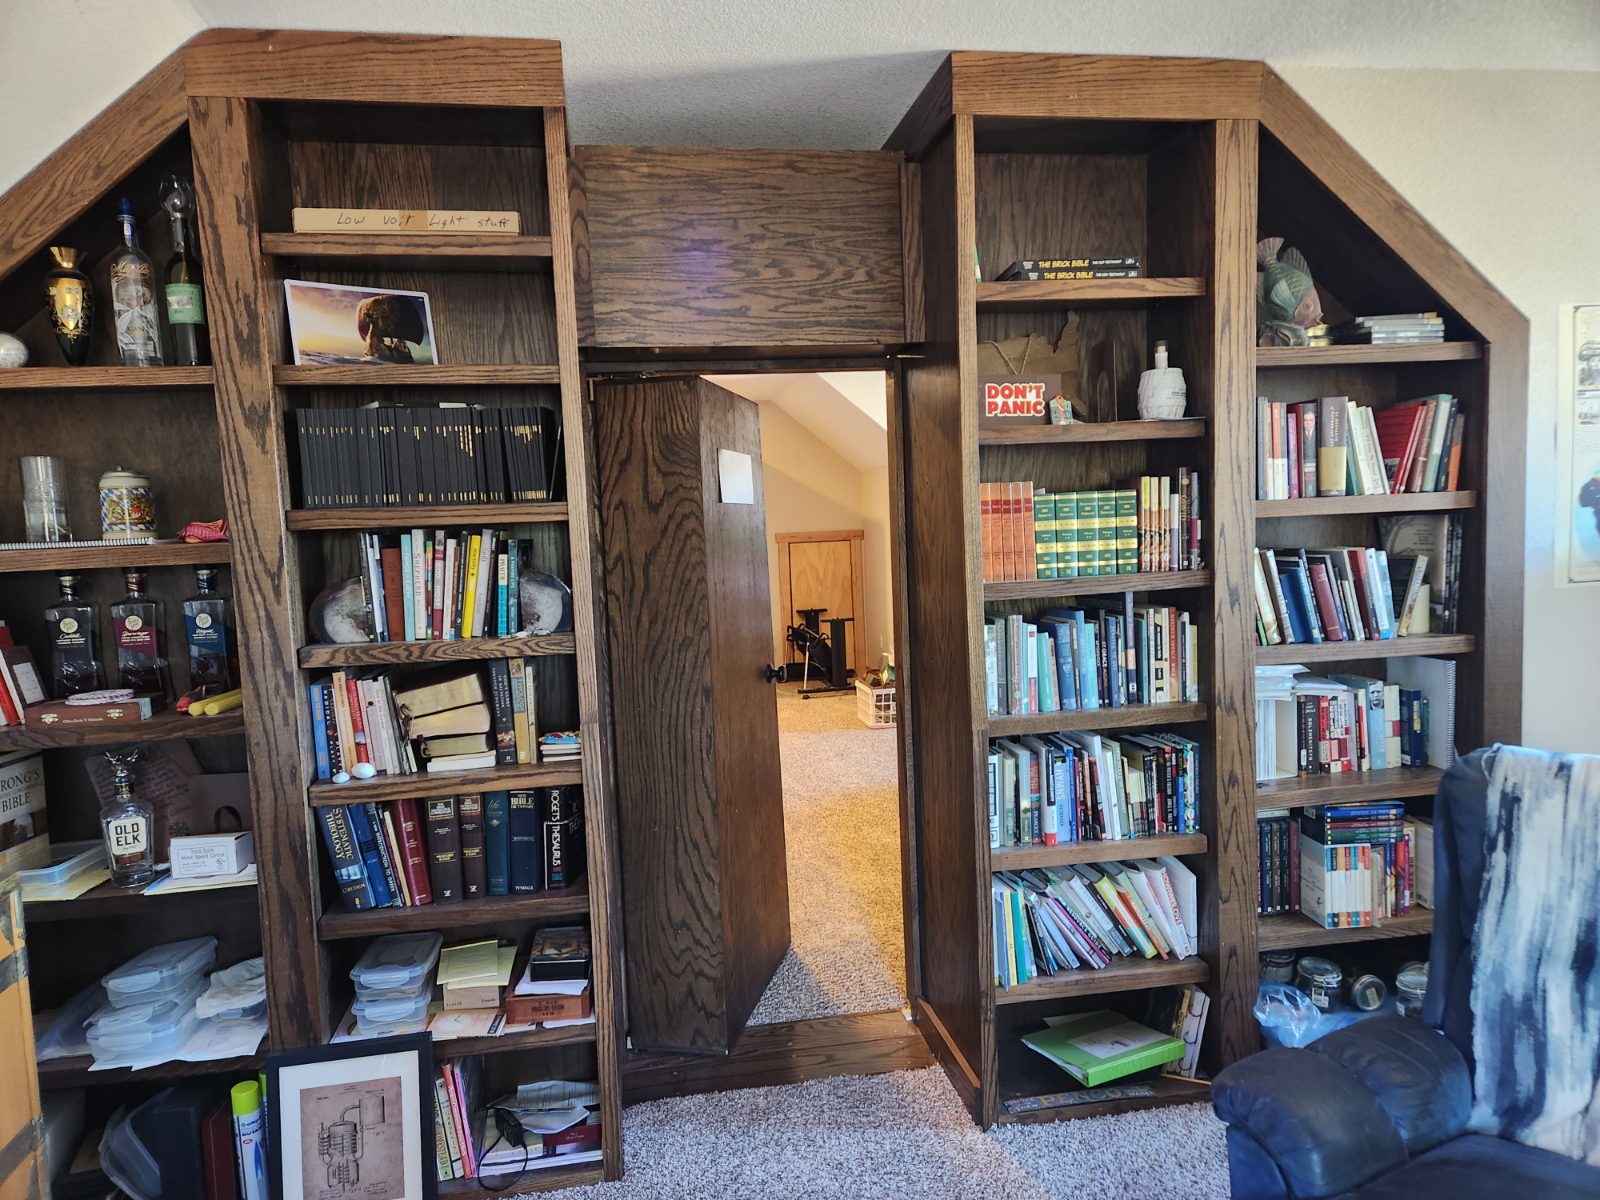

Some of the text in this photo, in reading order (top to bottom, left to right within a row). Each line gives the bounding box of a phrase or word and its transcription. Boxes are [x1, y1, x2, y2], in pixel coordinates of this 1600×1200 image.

[429, 213, 466, 229] Light
[1052, 260, 1071, 268] BRICK
[1072, 260, 1089, 268] BIBLE
[1057, 272, 1076, 280] BRICK
[986, 383, 1045, 400] DON'T
[986, 400, 1045, 416] PANIC
[412, 552, 421, 596] SHEPHERD
[321, 689, 336, 763] RADICAL PLATT
[1056, 769, 1064, 800] HYMNS
[2, 792, 31, 813] BIBLE
[511, 797, 534, 805] BIBLE
[115, 823, 140, 836] OLD
[325, 811, 346, 860] THEOLOGY
[332, 807, 354, 860] SYSTEMATIC
[116, 833, 141, 847] ELK
[552, 825, 561, 867] THESAURUS
[384, 867, 391, 876] TO
[1064, 905, 1089, 933] RESOURCE
